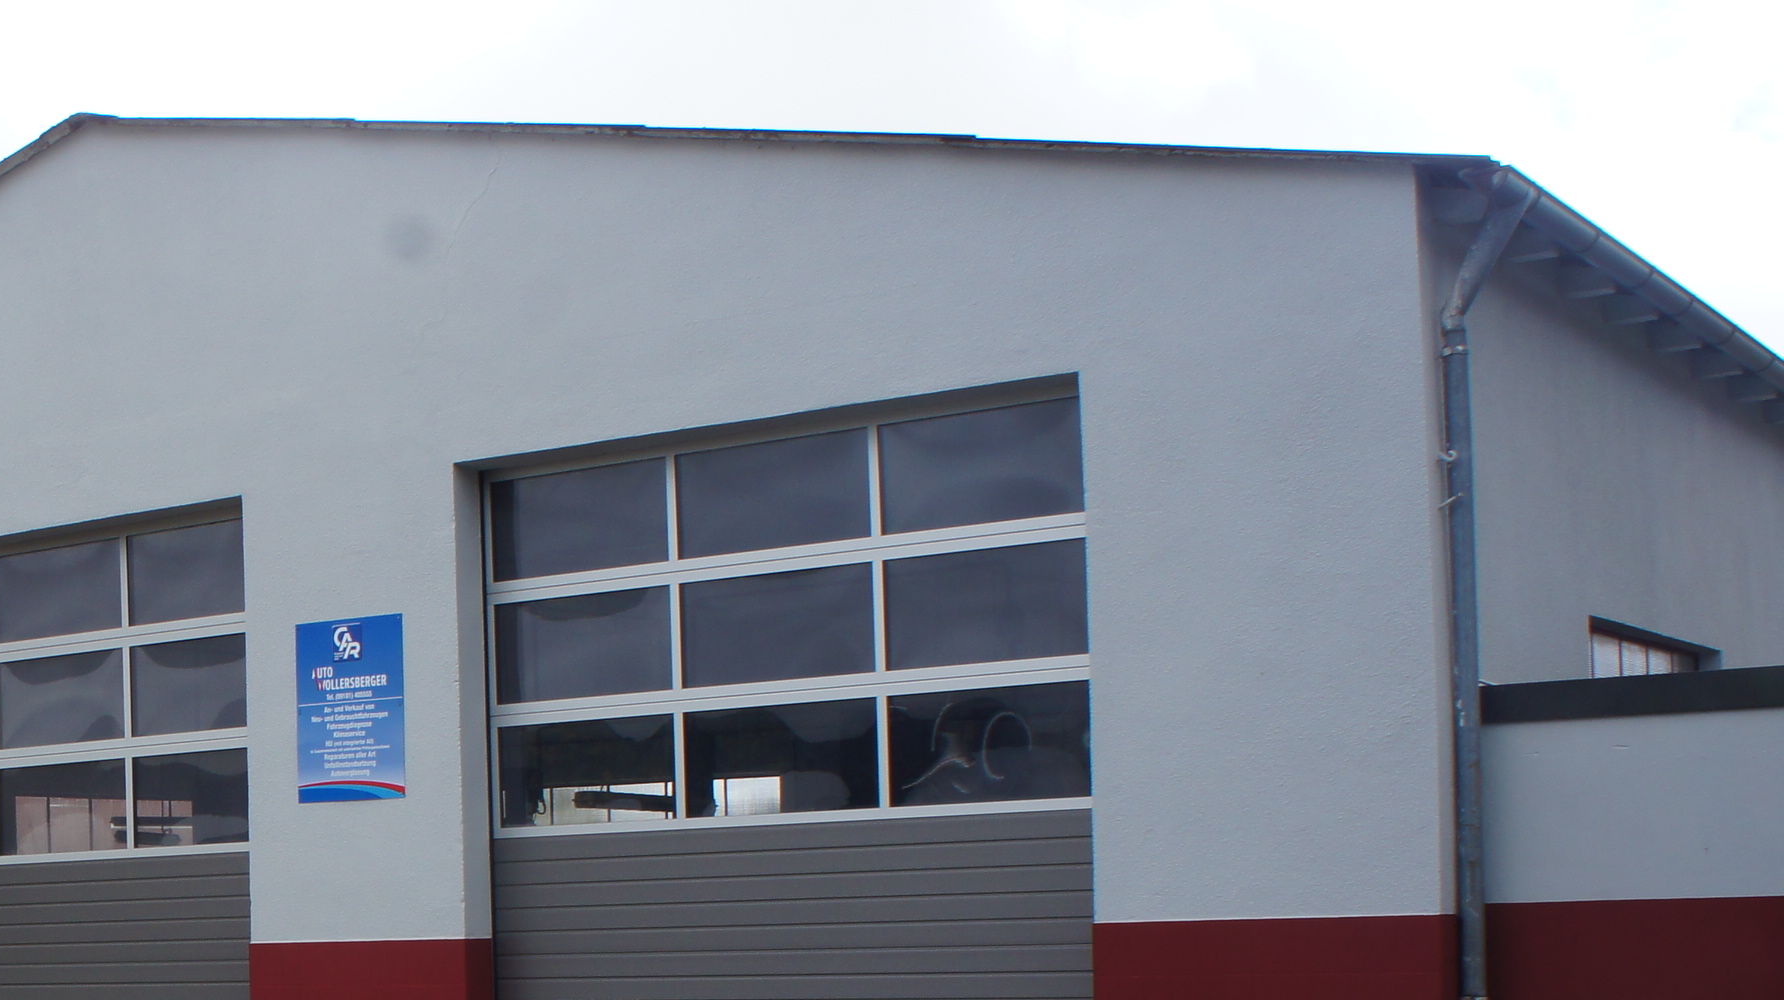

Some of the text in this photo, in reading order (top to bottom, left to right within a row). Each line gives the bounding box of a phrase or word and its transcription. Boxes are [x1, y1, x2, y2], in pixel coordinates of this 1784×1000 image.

[333, 626, 361, 660] CAR
[312, 666, 334, 679] AUTO
[316, 674, 387, 691] WOLLERSBERGER
